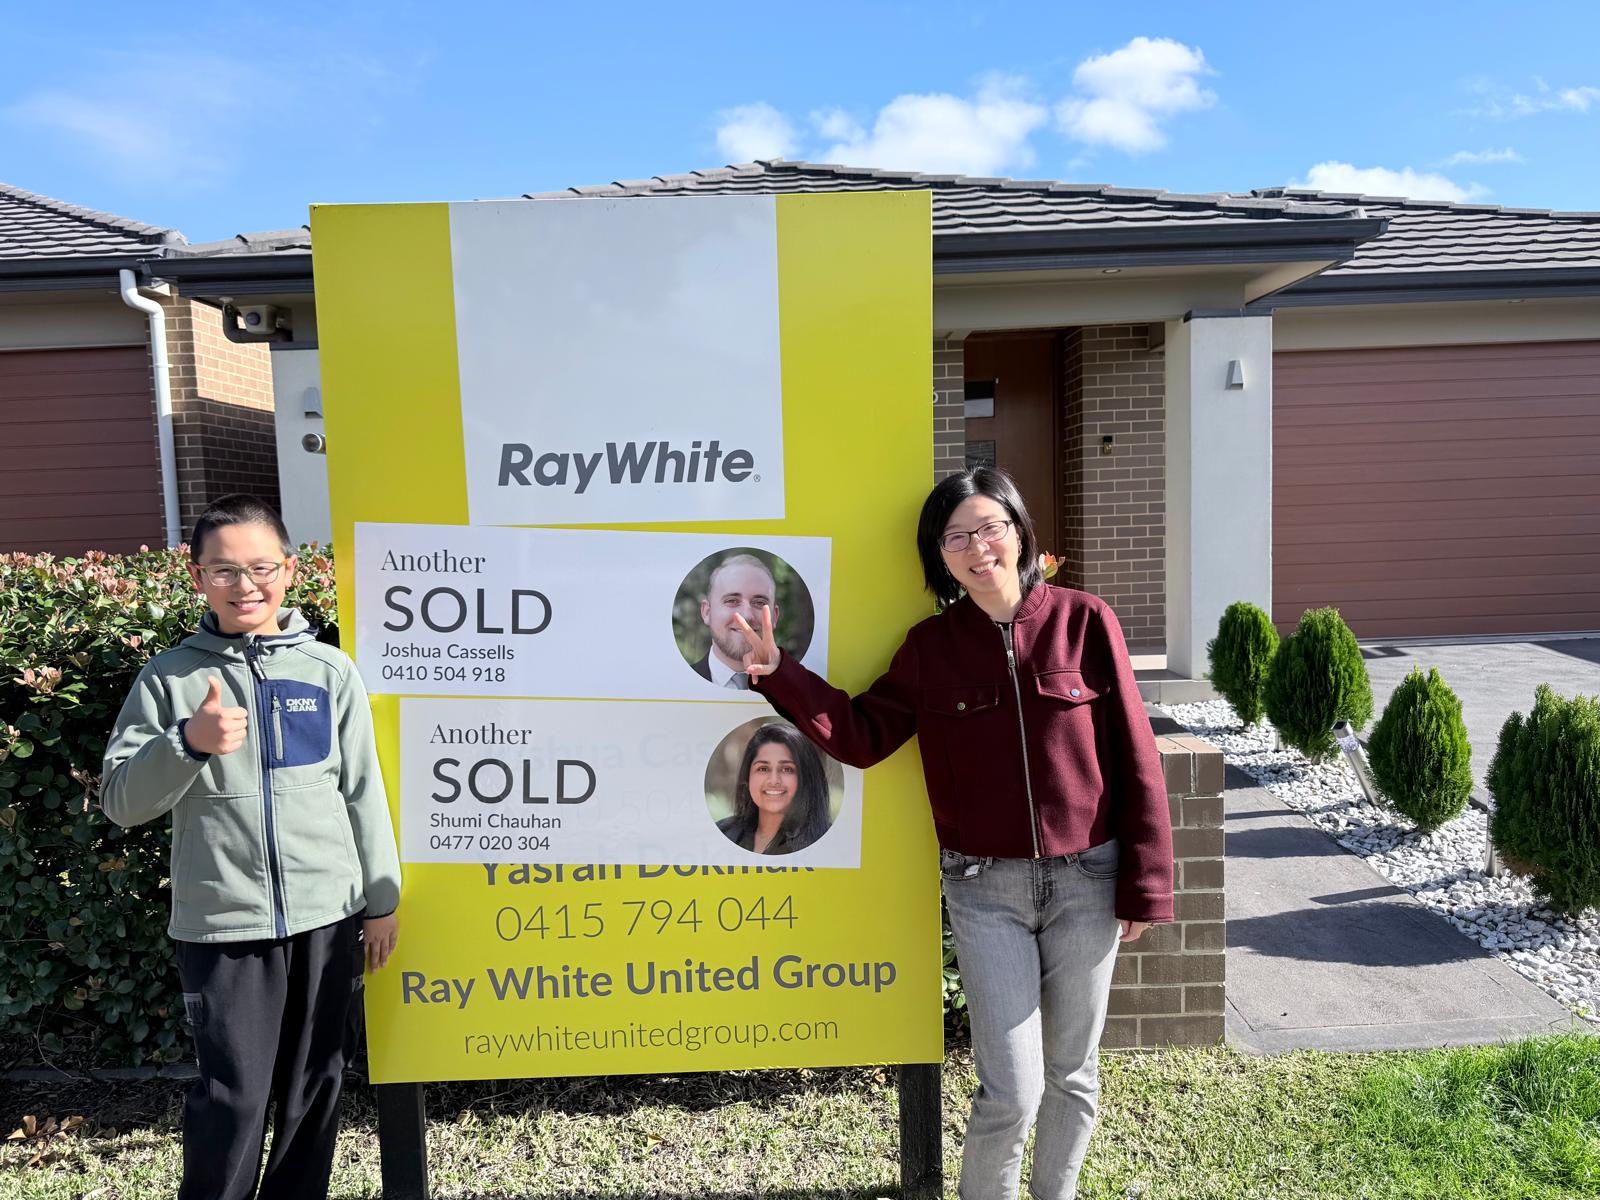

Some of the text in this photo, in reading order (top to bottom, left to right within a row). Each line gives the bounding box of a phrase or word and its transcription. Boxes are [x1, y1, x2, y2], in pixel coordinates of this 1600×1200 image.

[381, 549, 486, 574] Another
[383, 585, 553, 635] SOLD
[381, 642, 515, 660] Joshua Cassells
[381, 665, 506, 683] 0410 504 918
[285, 698, 317, 707] DKNY
[430, 722, 532, 745] Another
[431, 757, 597, 805] SOLD
[430, 813, 562, 829] Shumi Chauhan
[430, 835, 551, 851] 0477 020 304
[495, 895, 799, 942] 0415 794 044
[401, 971, 476, 1010] Ray
[486, 964, 613, 1001] White
[626, 955, 760, 996] United
[773, 954, 897, 993] Group
[464, 1020, 838, 1059] raywhiteunitedgroup.com
